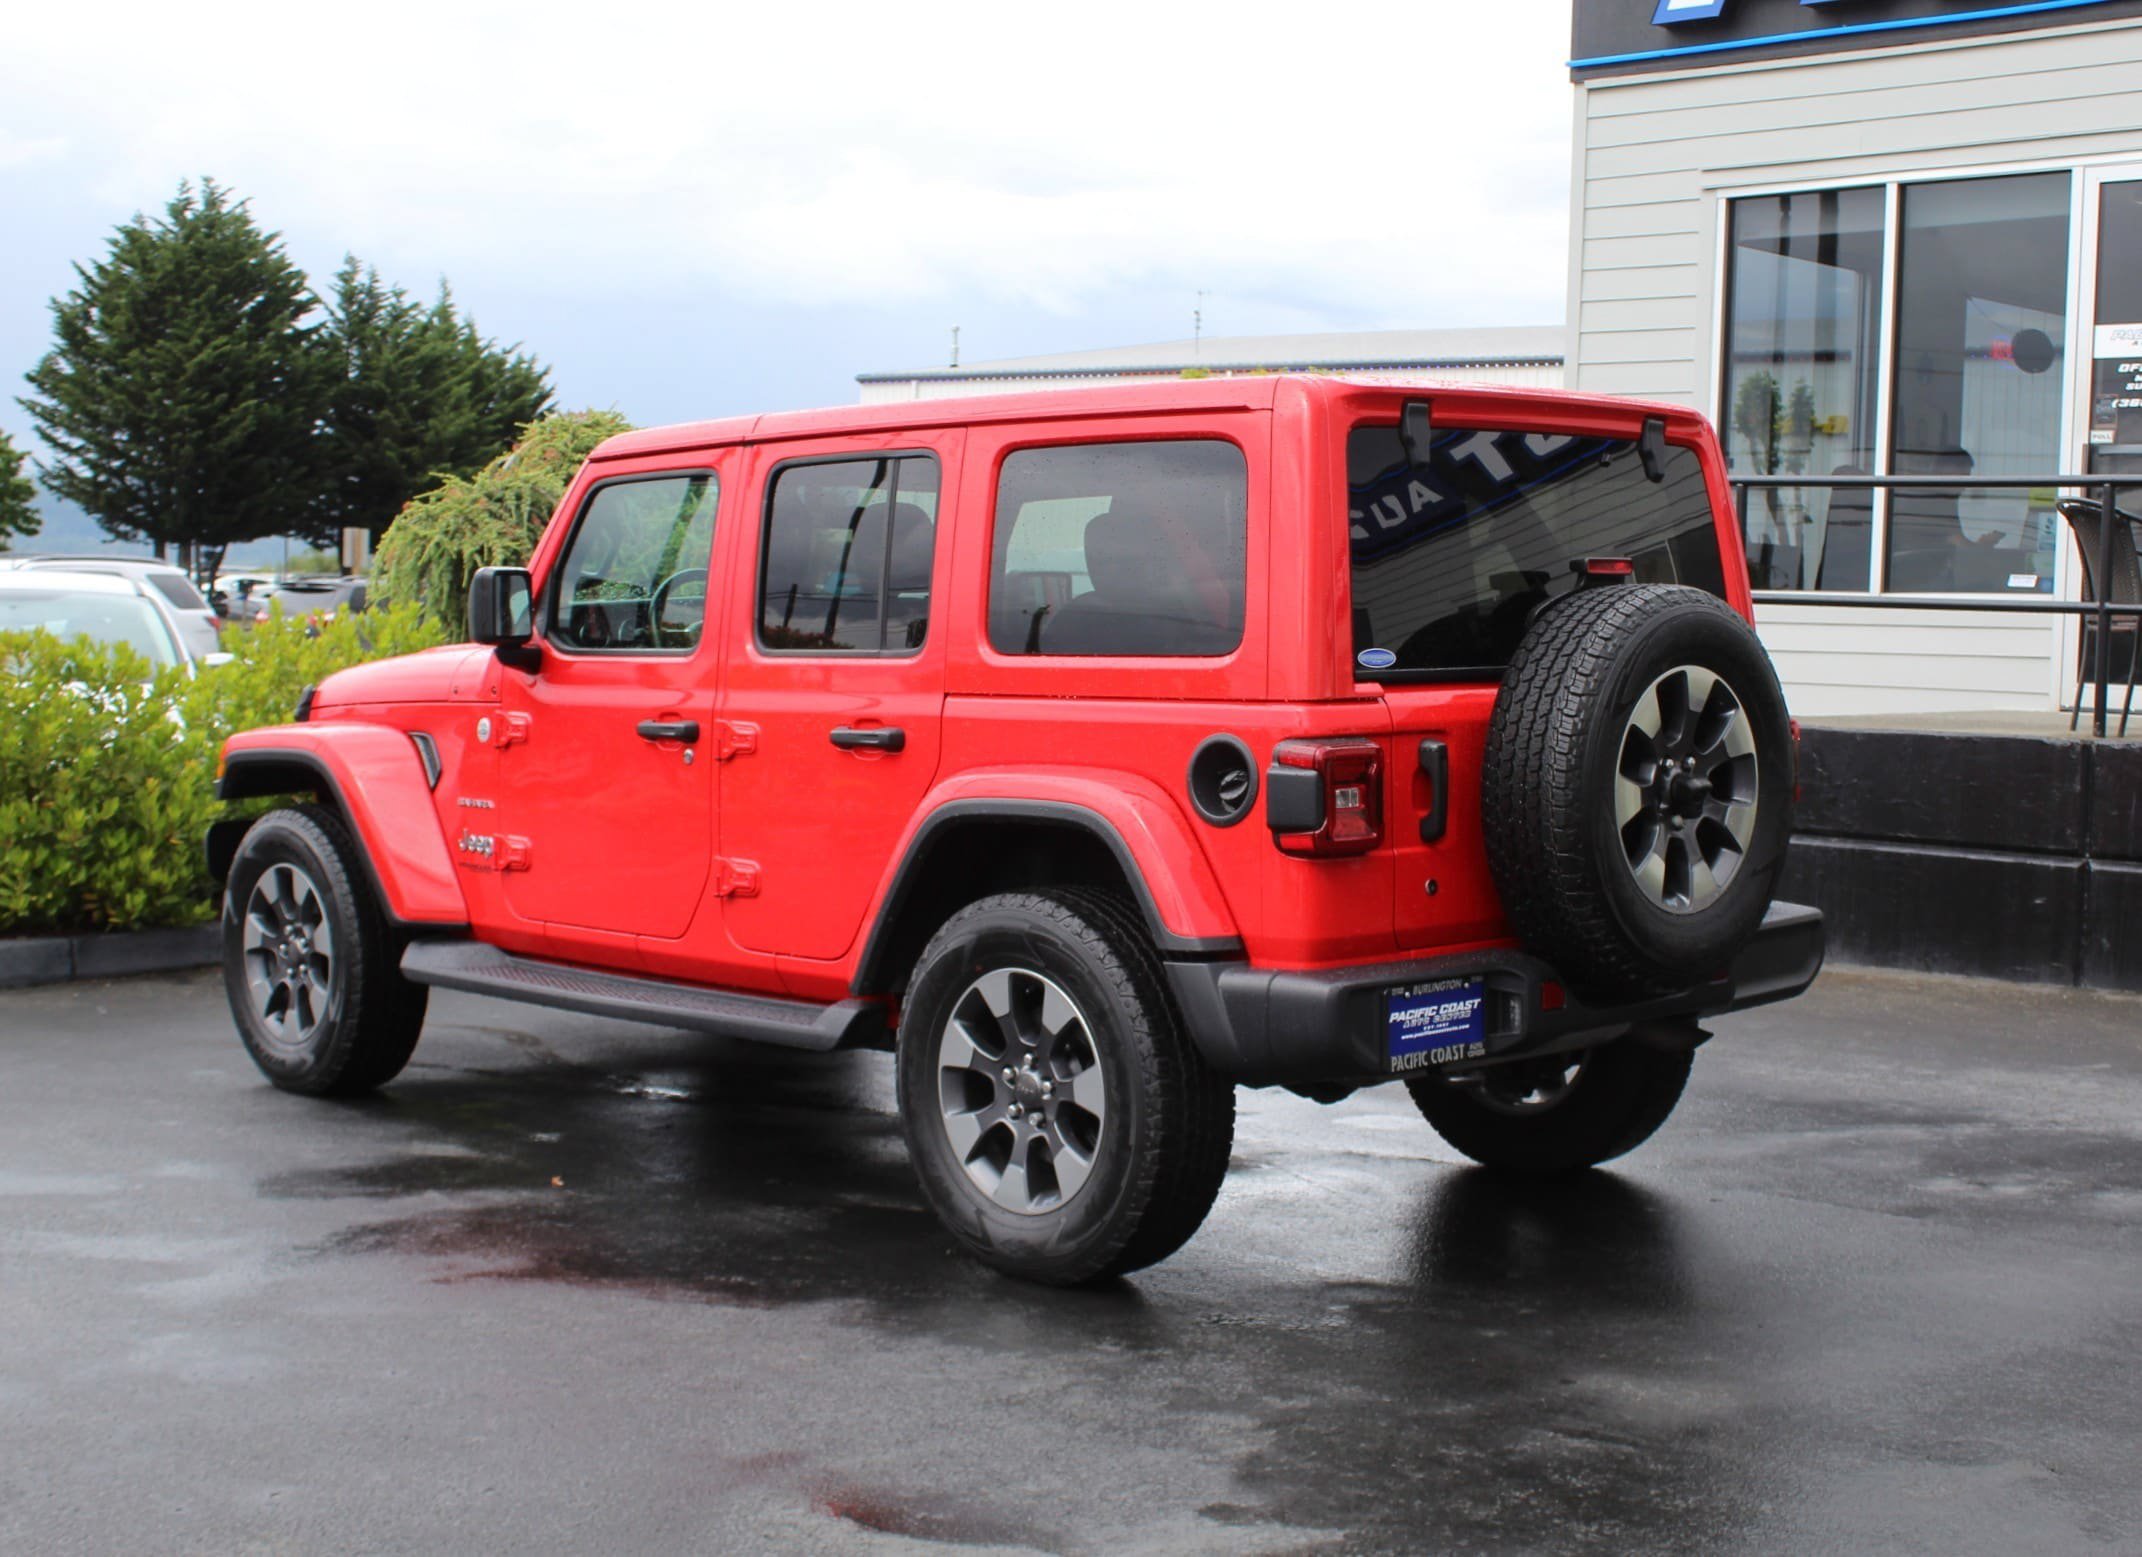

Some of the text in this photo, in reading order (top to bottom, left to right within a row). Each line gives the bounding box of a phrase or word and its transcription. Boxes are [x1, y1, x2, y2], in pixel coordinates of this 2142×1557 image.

[457, 828, 495, 860] Jeep
[1412, 979, 1463, 996] BURLINGTON
[1389, 998, 1482, 1023] PACIFIC COAST
[1391, 1043, 1465, 1072] PACIFIC COAST
